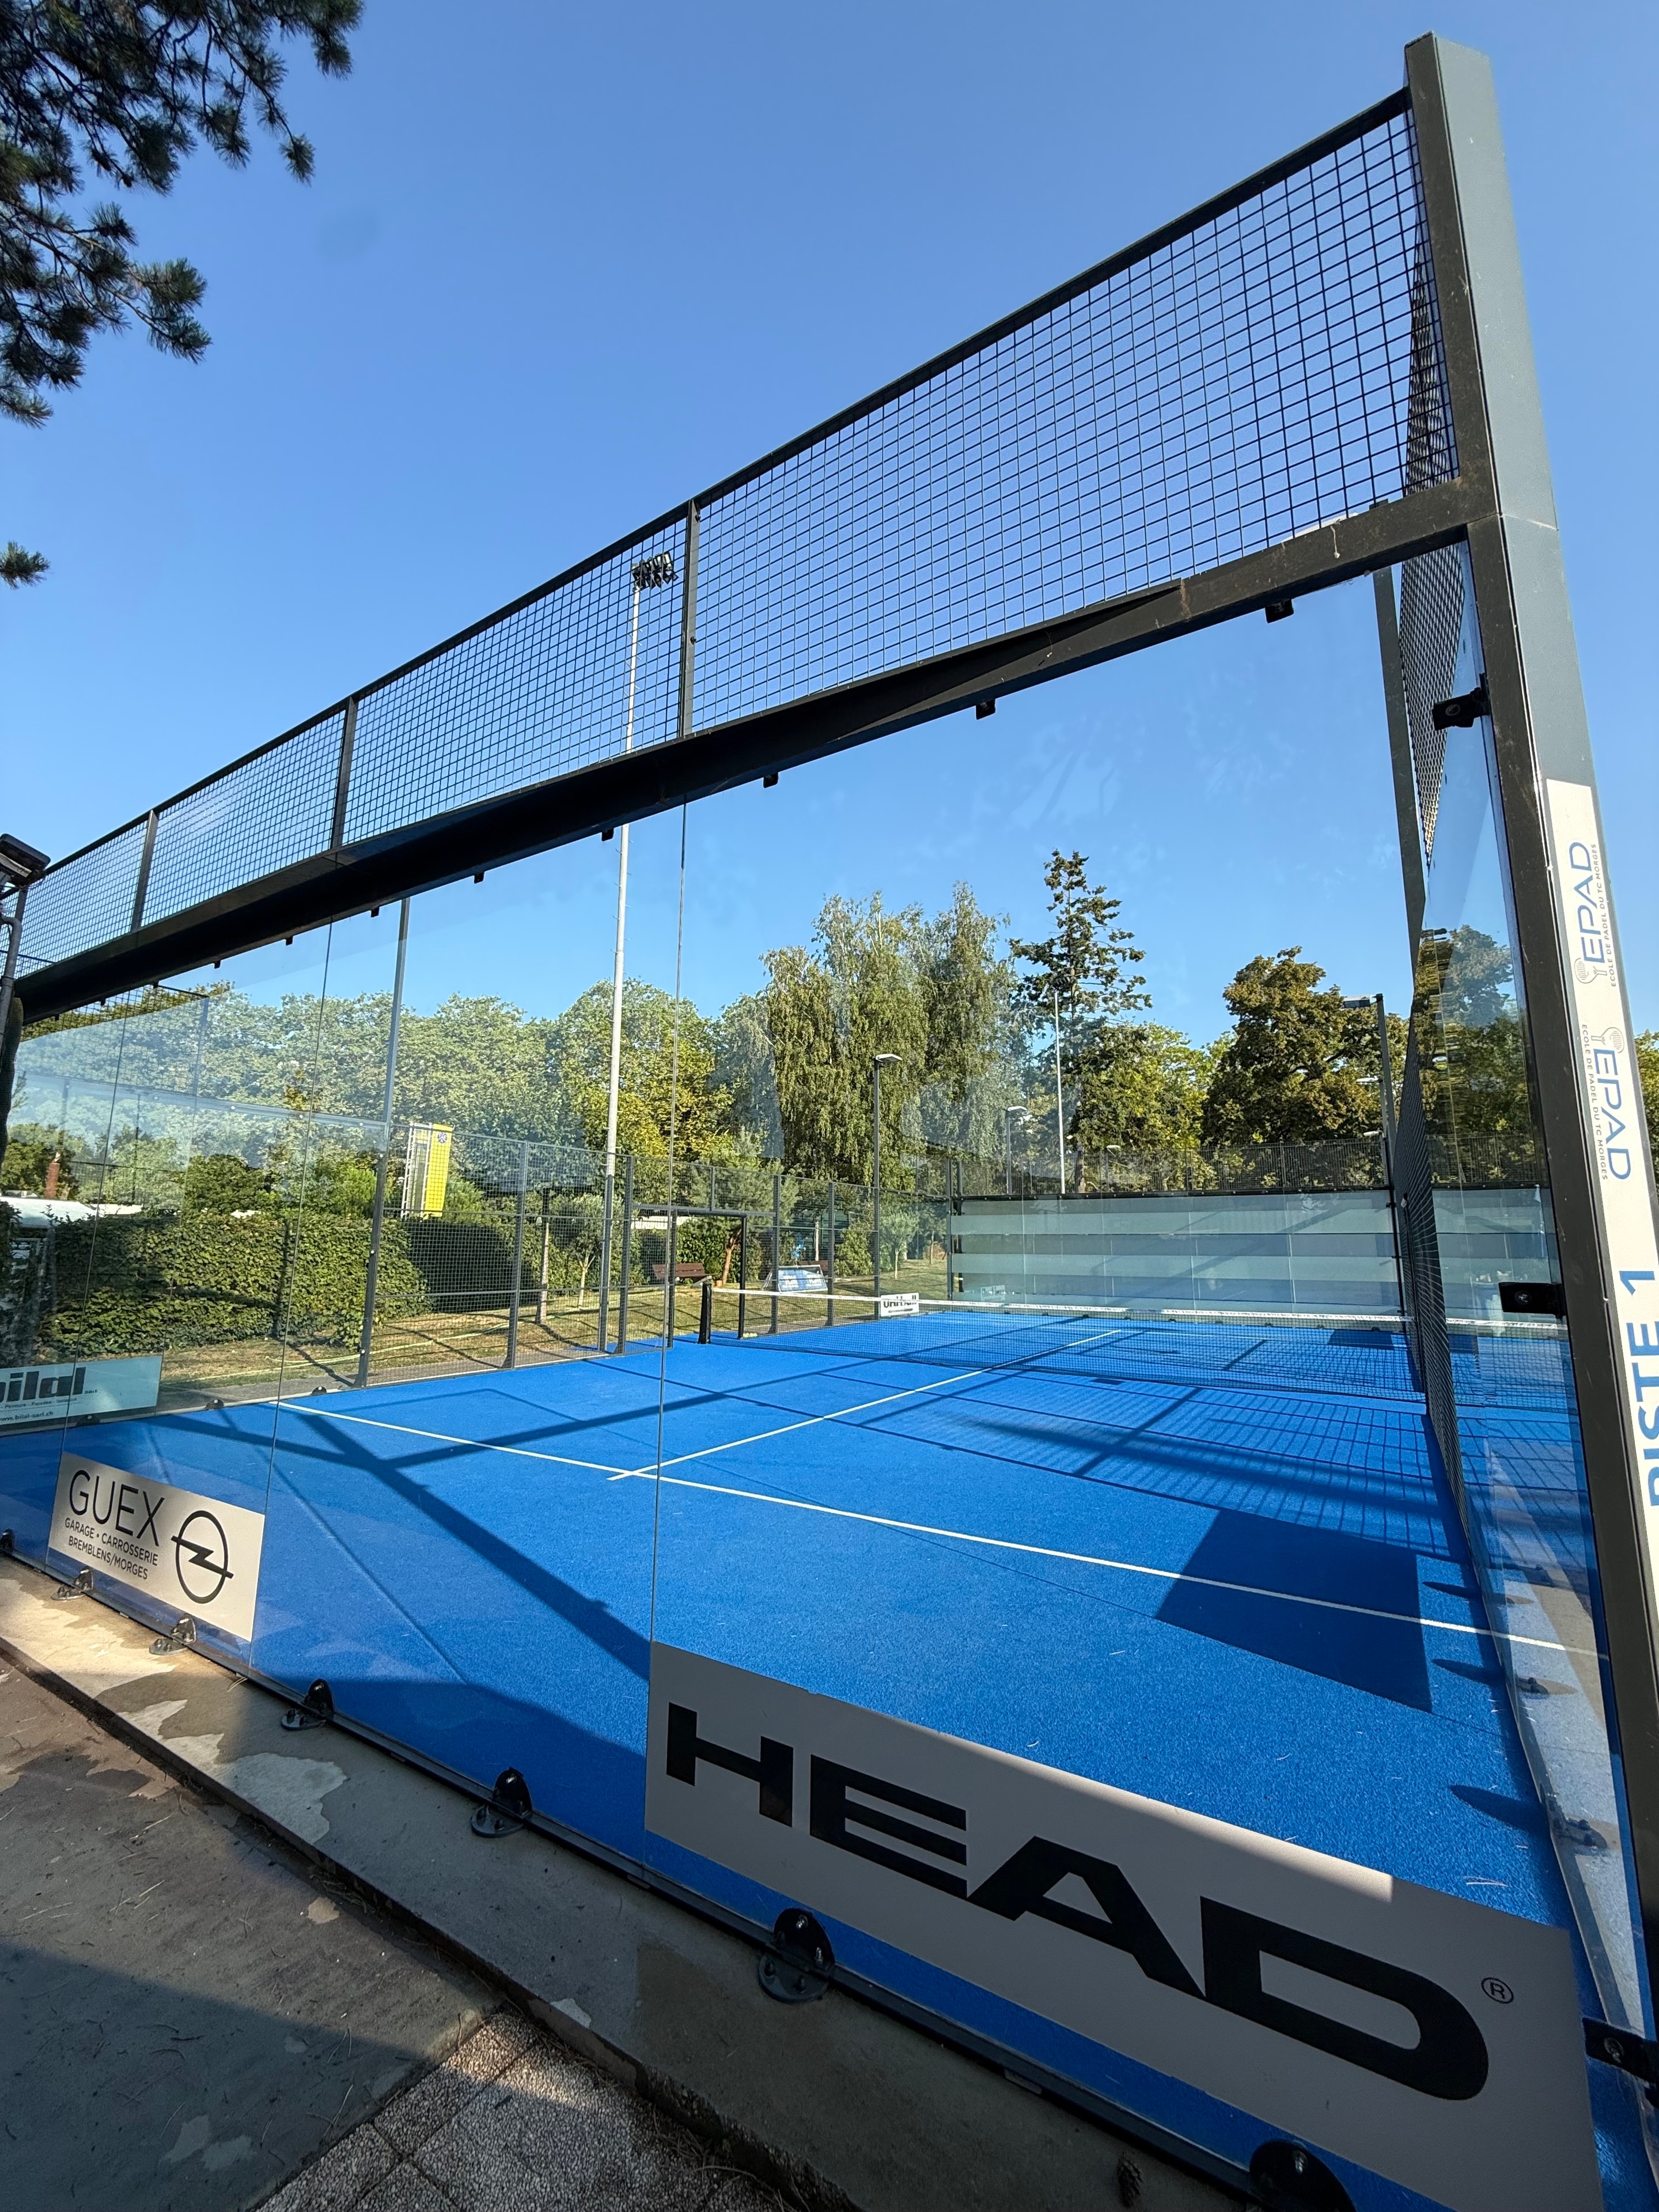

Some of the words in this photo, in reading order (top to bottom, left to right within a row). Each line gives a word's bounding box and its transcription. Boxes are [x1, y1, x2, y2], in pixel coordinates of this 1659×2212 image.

[1591, 844, 1600, 880] MORGES
[1569, 842, 1605, 963] EPAD
[1597, 882, 1603, 893] TC
[1600, 897, 1605, 910] DU
[1601, 912, 1610, 940] PADEL
[1605, 942, 1612, 954] DE
[1607, 958, 1616, 987] ECOLE
[1582, 1024, 1591, 1054] ECOLE
[1586, 1058, 1593, 1070] DE
[1588, 1073, 1597, 1103] PADEL
[1593, 1107, 1600, 1120] DU
[1593, 1048, 1631, 1180] EPAD
[1595, 1124, 1602, 1136] TC
[1597, 1139, 1608, 1180] MORGES
[1619, 1271, 1655, 1295] 1
[0, 1366, 86, 1403] ilal
[69, 1469, 165, 1547] GUEX
[65, 1517, 94, 1539] GARAGE
[101, 1532, 158, 1566] CARROSSERIE
[68, 1535, 149, 1580] BREMBLENS/MORGES
[666, 1702, 1489, 2101] HEAD
